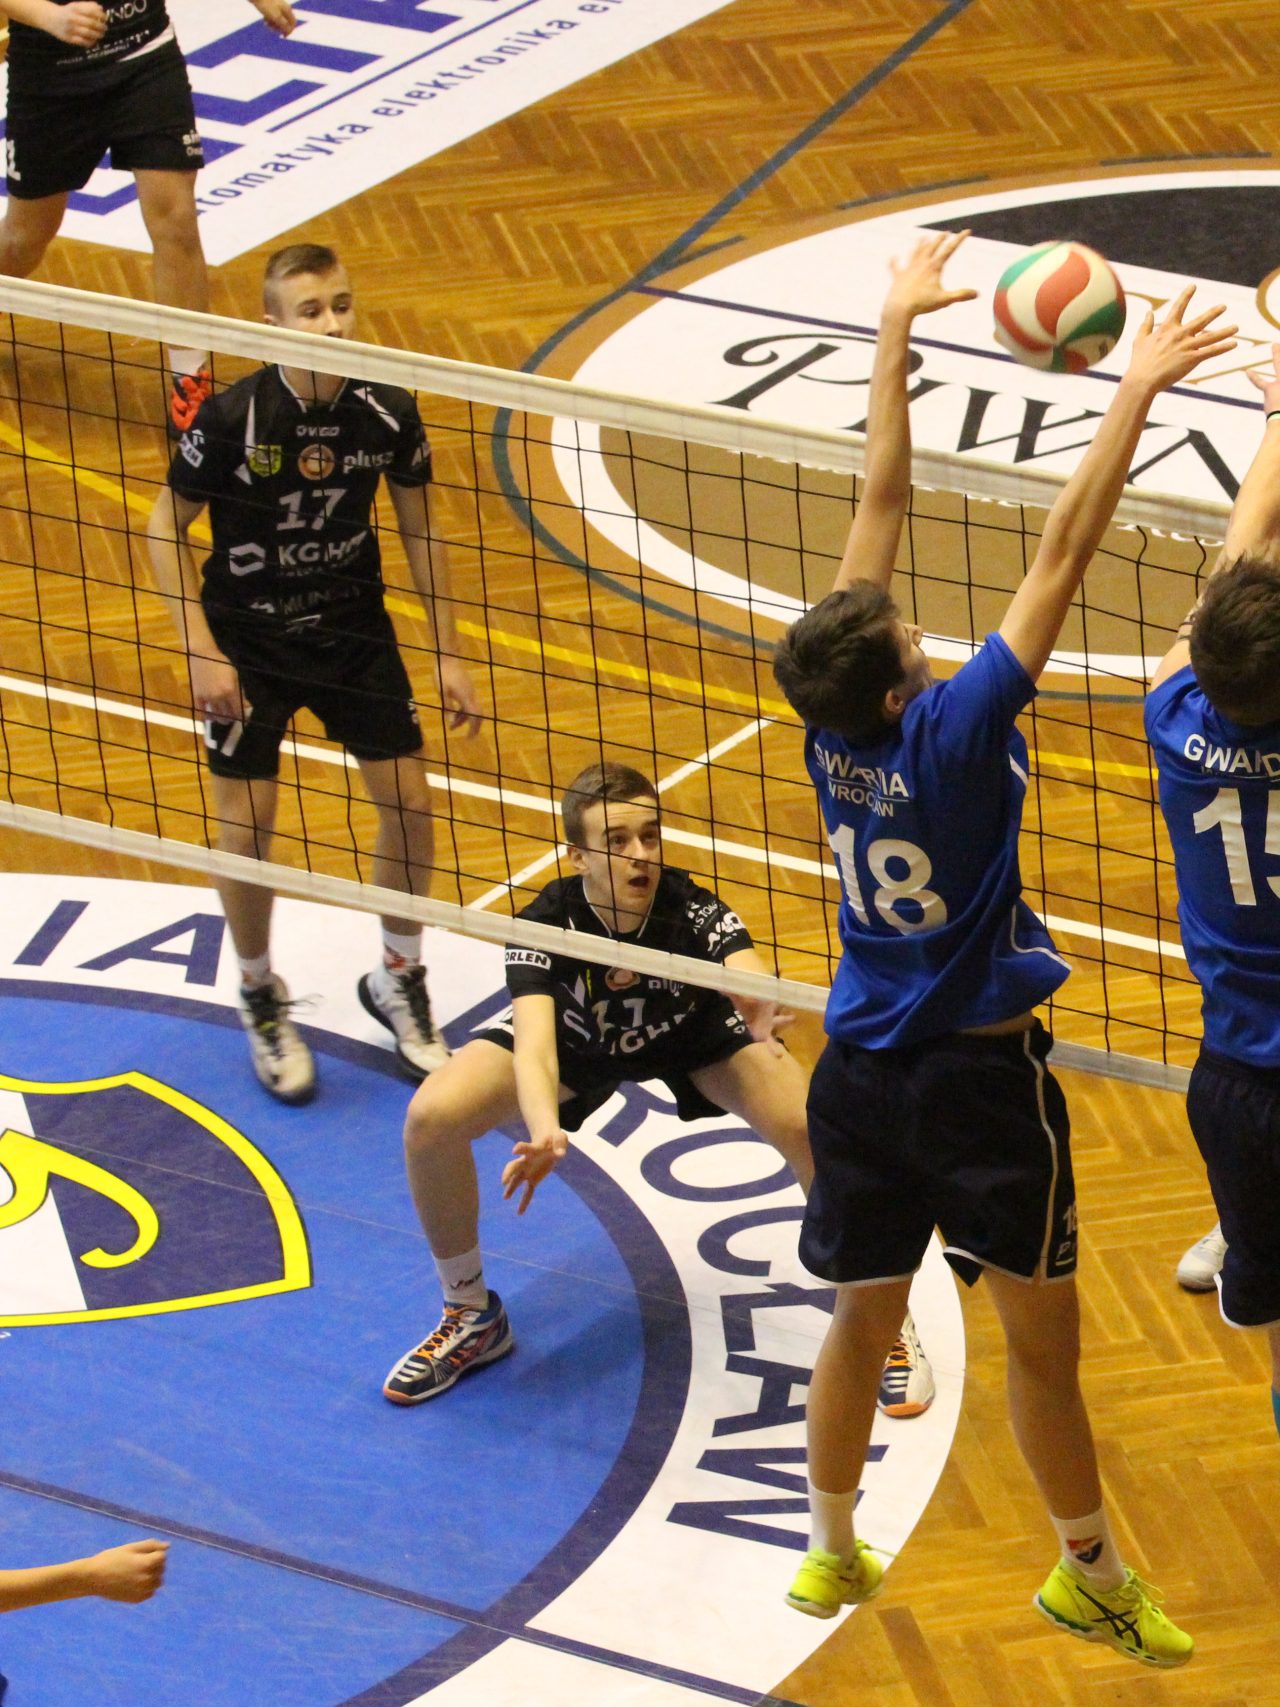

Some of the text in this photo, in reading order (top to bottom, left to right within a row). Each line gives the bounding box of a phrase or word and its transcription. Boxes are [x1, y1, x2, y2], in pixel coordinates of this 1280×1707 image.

[194, 121, 373, 216] tomatyka
[372, 18, 579, 119] elektronika
[276, 488, 348, 531] 17
[814, 741, 910, 798] GWARIA
[827, 822, 948, 936] 18
[505, 950, 549, 967] ORLEN
